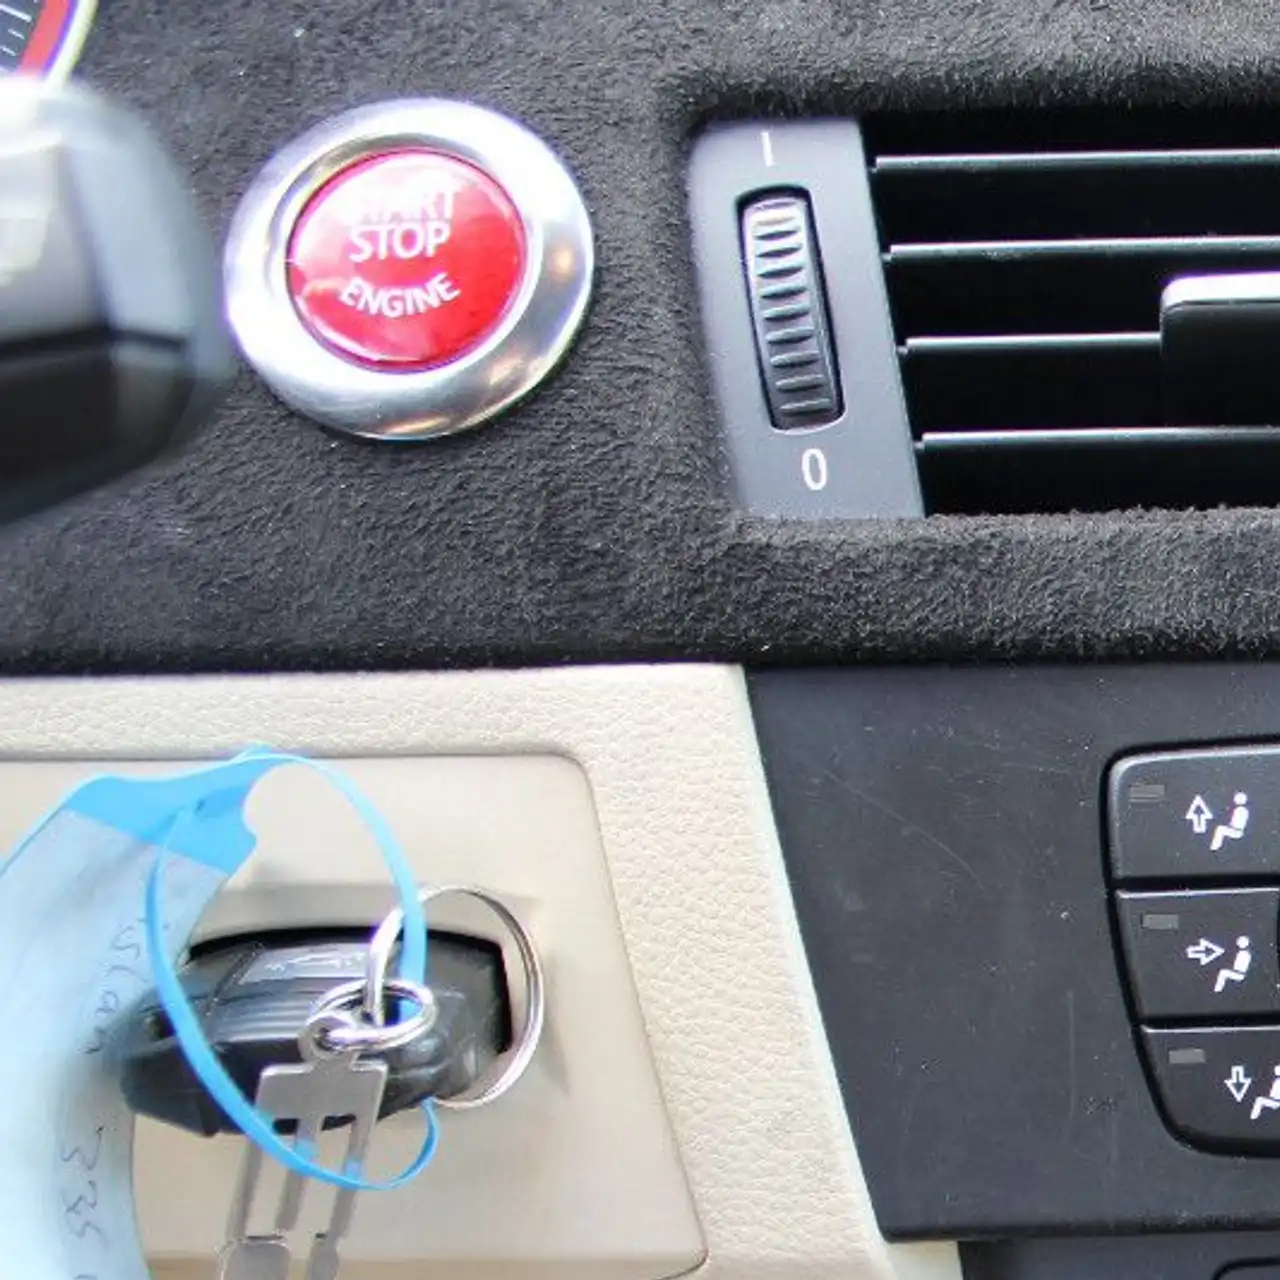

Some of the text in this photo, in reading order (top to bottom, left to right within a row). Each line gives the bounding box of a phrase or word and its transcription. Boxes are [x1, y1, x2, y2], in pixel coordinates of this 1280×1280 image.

[349, 184, 462, 227] TART
[348, 220, 453, 262] STOP
[340, 273, 461, 318] ENGINE
[802, 449, 827, 490] 0
